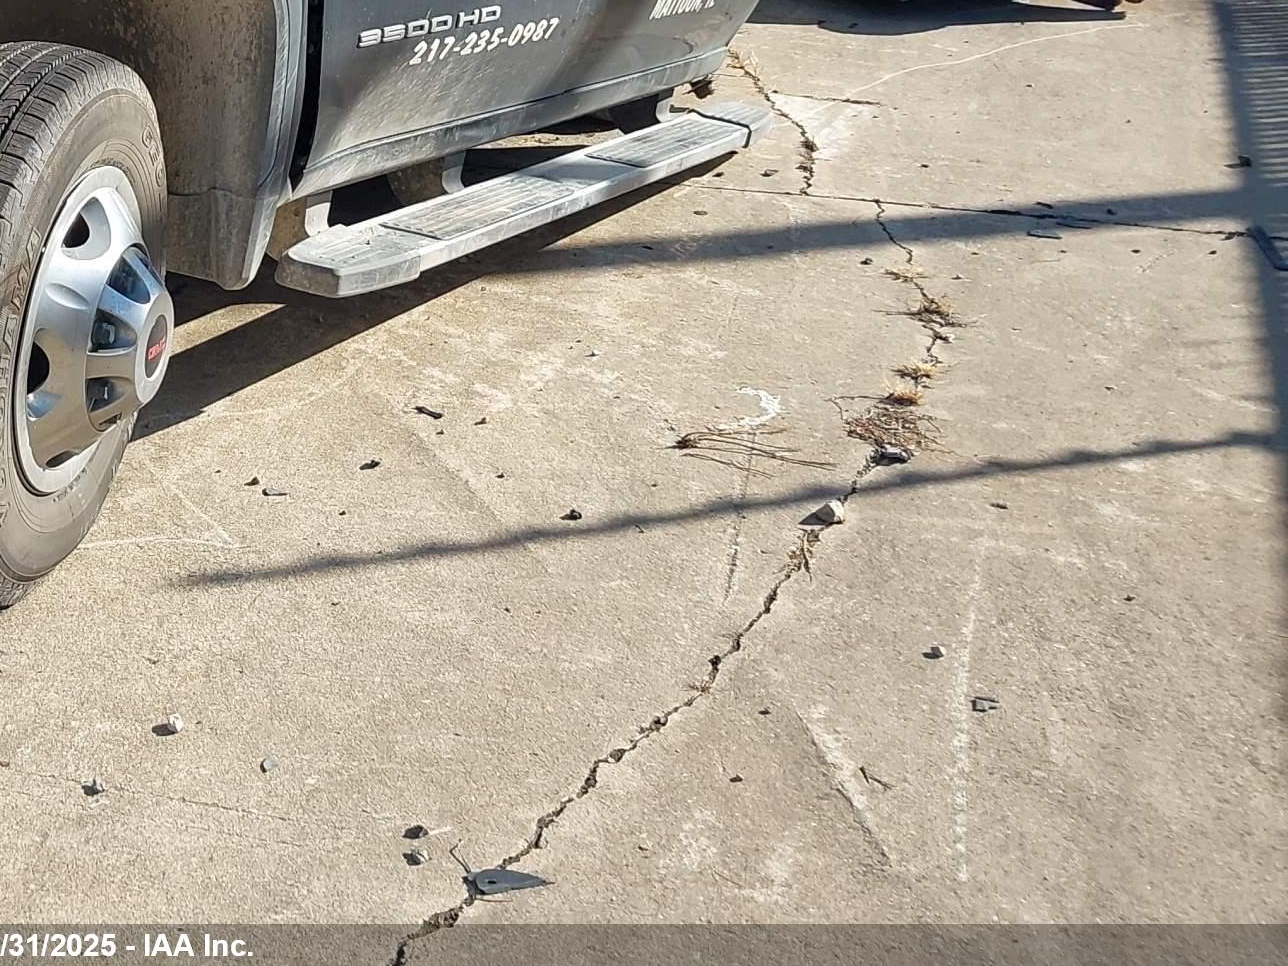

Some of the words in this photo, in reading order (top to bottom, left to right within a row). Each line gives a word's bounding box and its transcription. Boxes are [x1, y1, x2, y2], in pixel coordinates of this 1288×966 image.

[357, 14, 453, 48] 3500
[455, 5, 502, 29] HD
[409, 17, 560, 66] 217-235-0987
